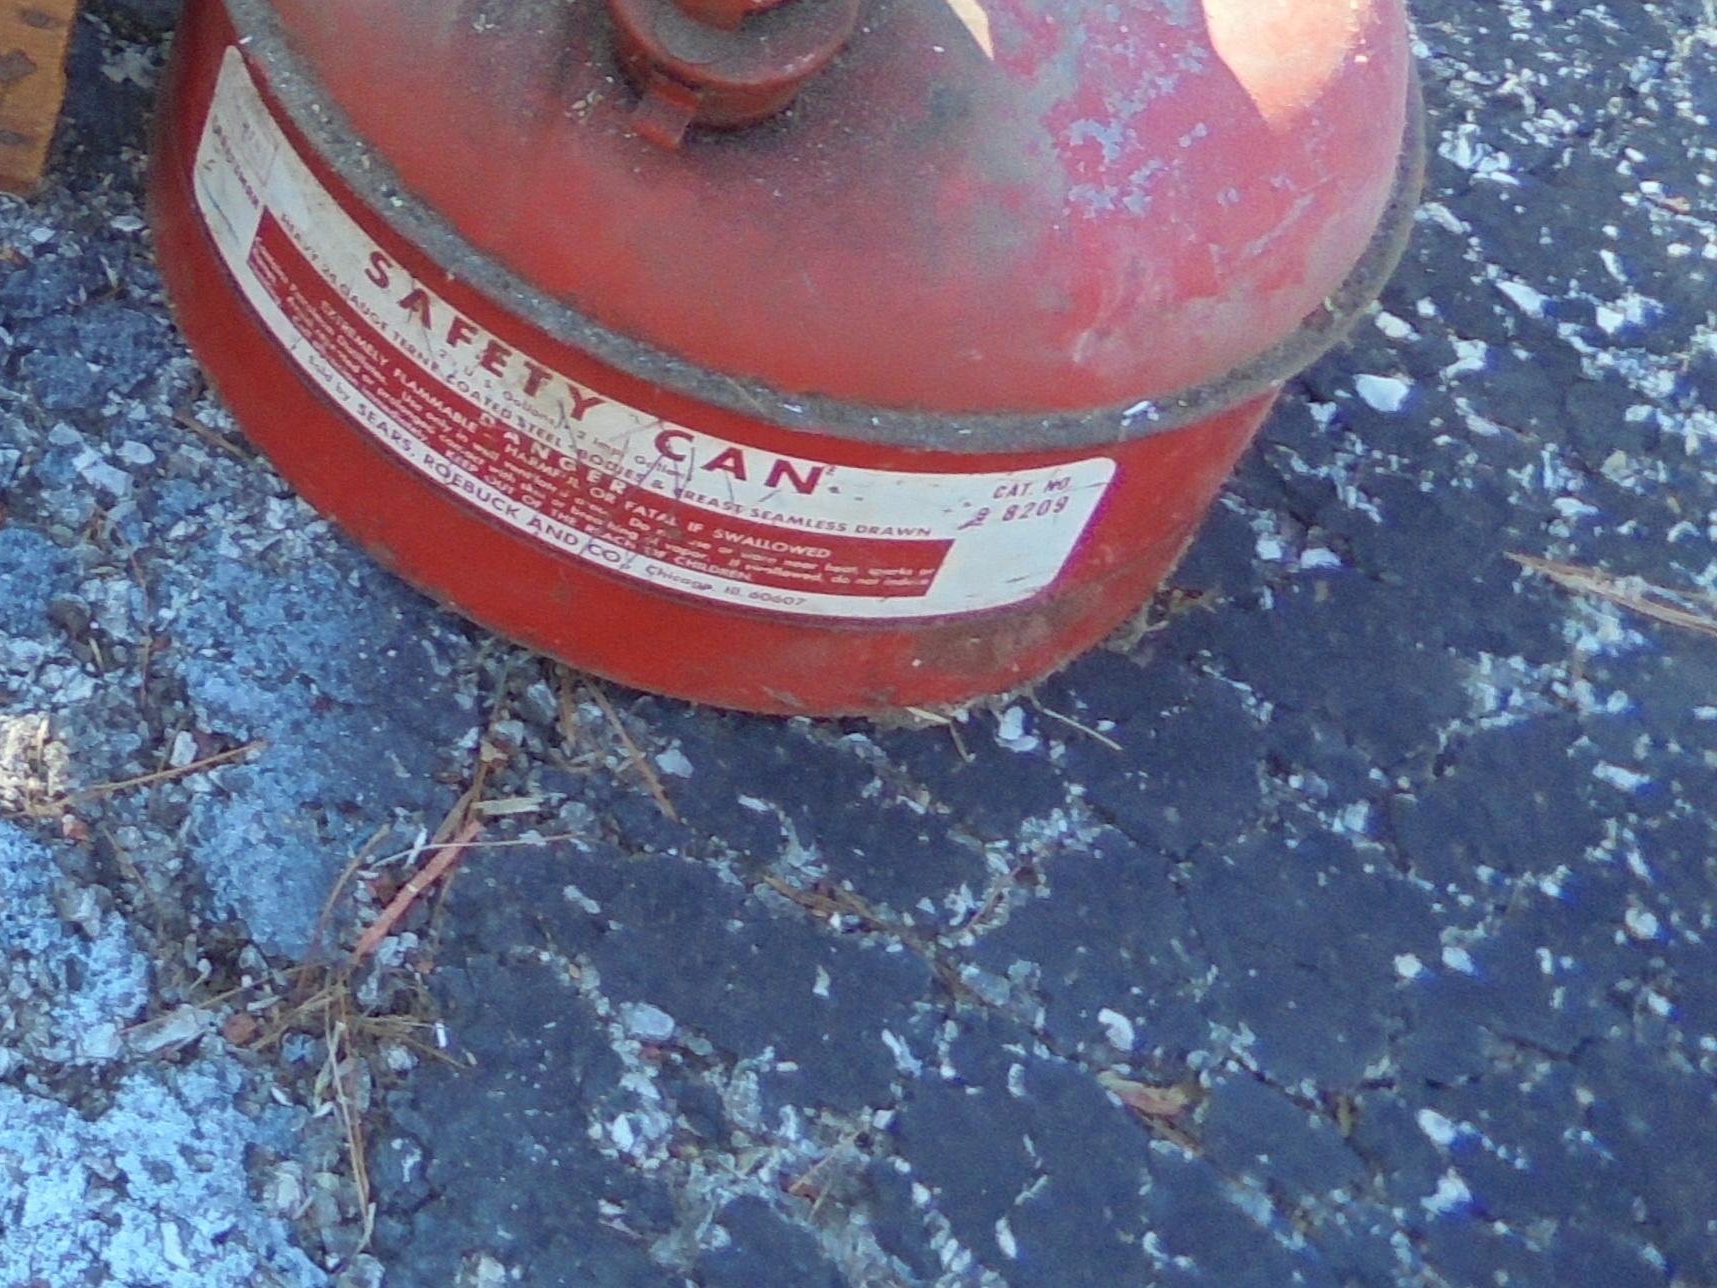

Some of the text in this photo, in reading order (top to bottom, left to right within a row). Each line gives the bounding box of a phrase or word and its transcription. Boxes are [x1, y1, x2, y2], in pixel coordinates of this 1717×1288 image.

[321, 299, 389, 367] EXTREMELY
[393, 367, 478, 434] FLAMMABLE
[589, 486, 617, 505] OR
[625, 500, 678, 527] FATAL
[686, 521, 705, 533] IF
[712, 528, 832, 559] SWALLOWED
[339, 283, 389, 332] GAUGE
[445, 372, 512, 420] COATED
[516, 414, 562, 449] STEEL
[577, 448, 646, 484] BODIES
[749, 507, 848, 533] SEAMLESS
[853, 523, 933, 537] DRAWN
[364, 250, 826, 495] SAFETY CAN
[478, 411, 627, 495] DANGER
[335, 381, 351, 402] by
[356, 401, 416, 458] SEARS,
[423, 453, 522, 520] ROEBUCK
[526, 516, 579, 546] AND
[748, 591, 808, 606] 60607
[521, 493, 543, 509] OF
[550, 507, 577, 525] THE
[1002, 495, 1070, 522] 8209
